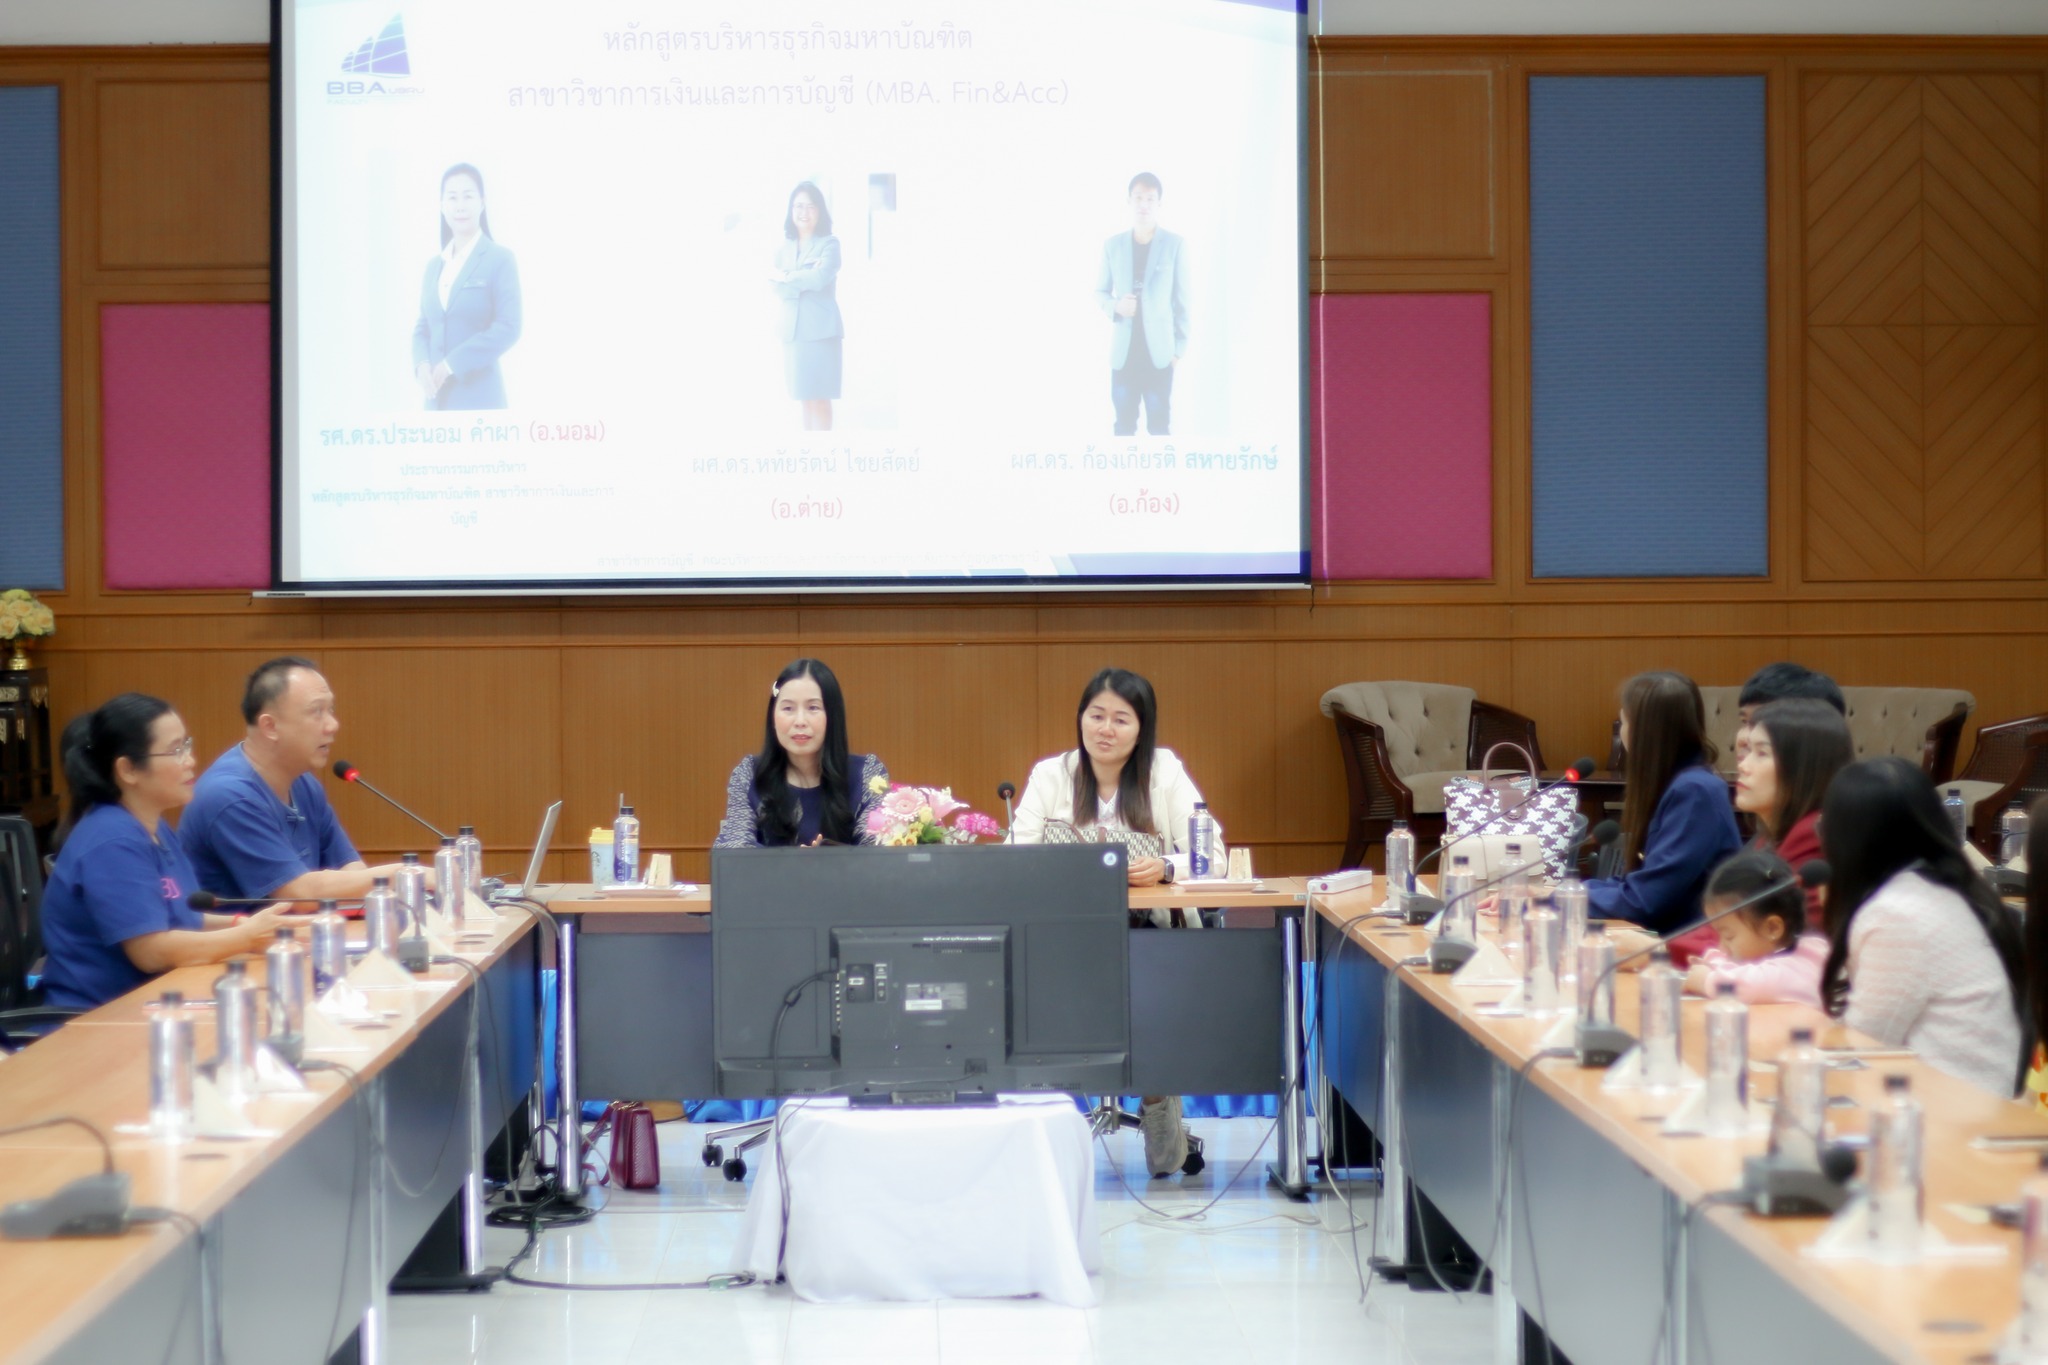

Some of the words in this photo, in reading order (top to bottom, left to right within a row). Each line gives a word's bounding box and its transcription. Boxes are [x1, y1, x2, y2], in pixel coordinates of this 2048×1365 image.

[603, 20, 972, 61] หลักสูตรบริหารธุรกิจมหาบัณฑิต
[326, 80, 386, 95] BBA
[508, 75, 854, 113] สาขาวิชาการเงินและการบัญชี
[865, 79, 941, 107] (MBA.
[952, 78, 1069, 106] Fin&Acc)
[320, 423, 461, 446] รศ.ดร.ประนอม
[470, 418, 520, 443] คำผา
[528, 419, 606, 443] (อ.นอม)
[692, 448, 837, 474] ผศ.ดร.หทัยรัตน์
[844, 447, 921, 473] ไชยสัตย์
[1011, 451, 1074, 471] ผศ.ดร.
[1082, 444, 1177, 471] ก้องเกียรติ
[1184, 444, 1279, 471] สหายรักษ์
[770, 495, 843, 521] (อ.ต่าย)
[1109, 488, 1180, 515] (อ.ก้อง)
